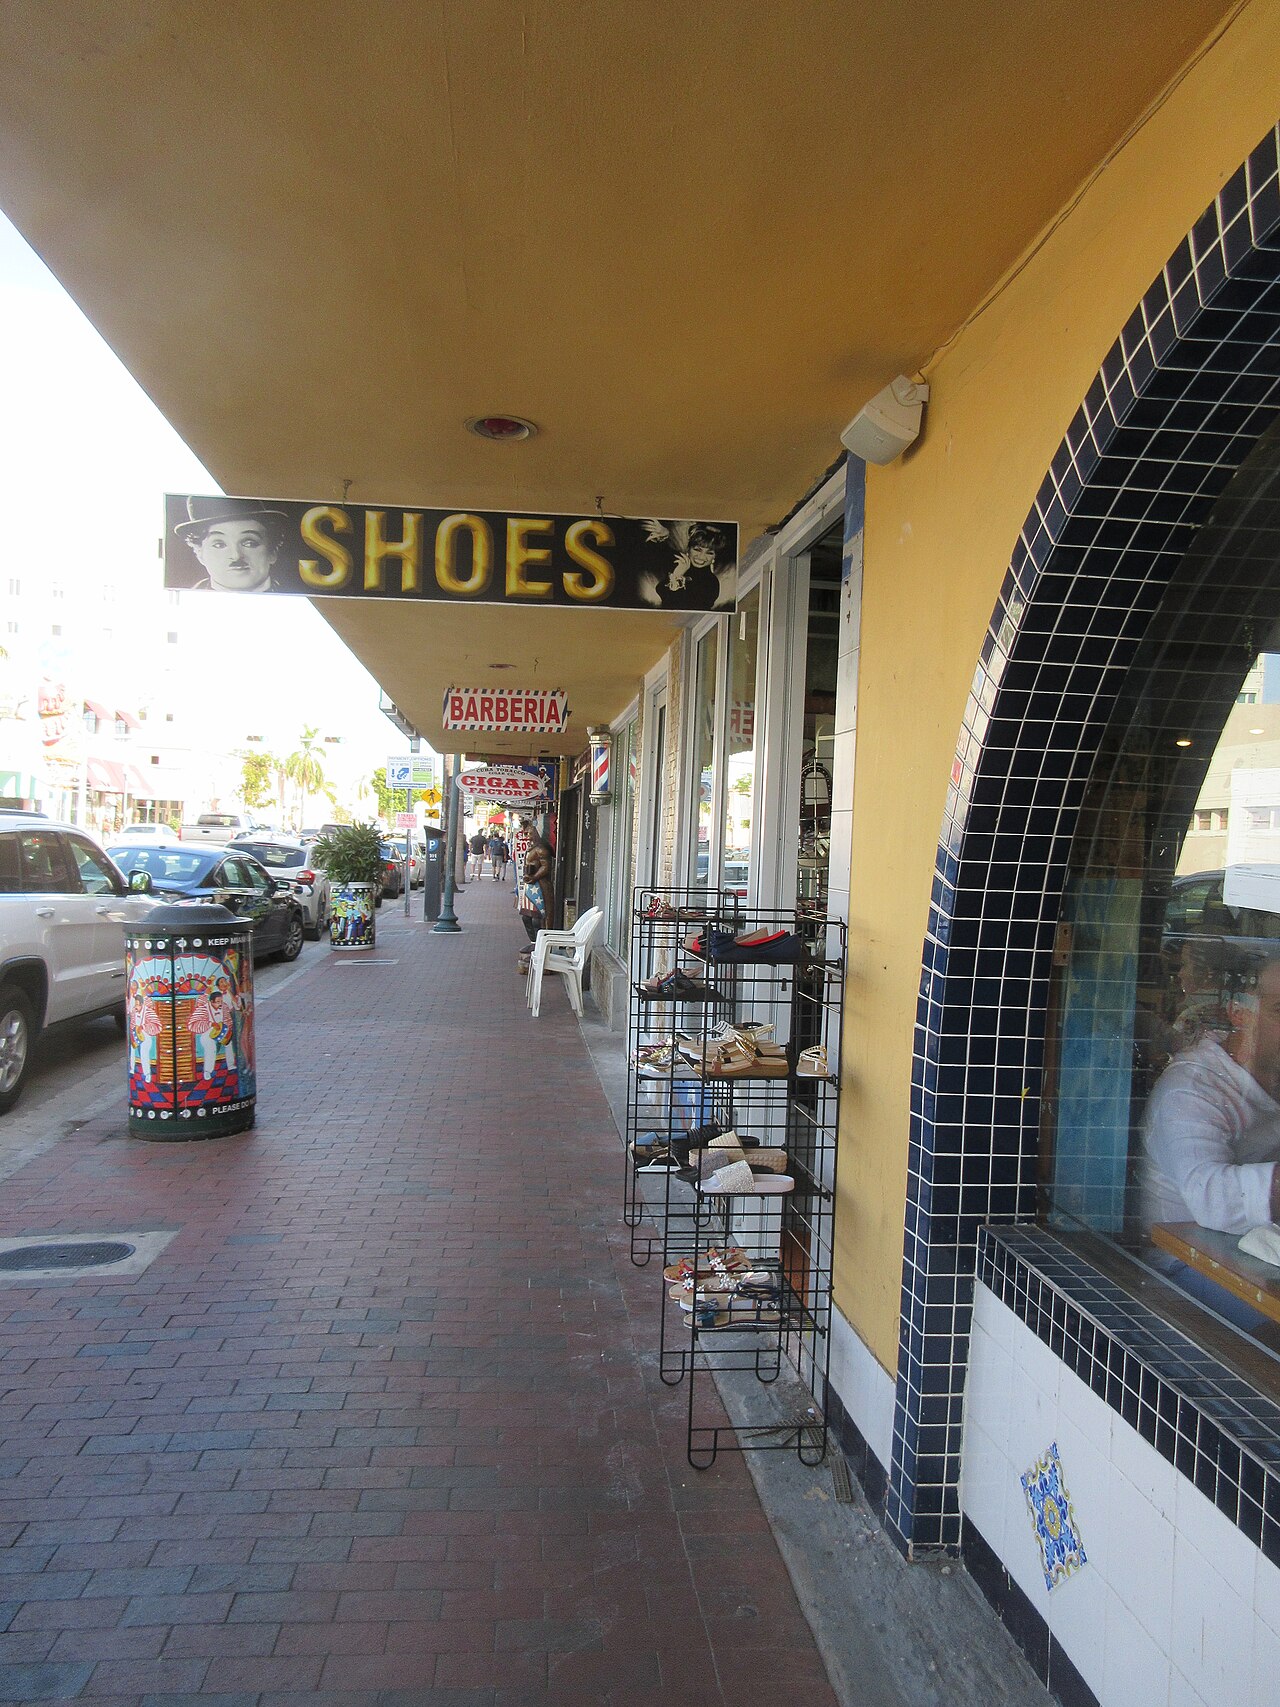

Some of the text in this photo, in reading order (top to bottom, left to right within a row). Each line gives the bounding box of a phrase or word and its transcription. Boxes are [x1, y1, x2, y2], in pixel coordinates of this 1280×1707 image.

[298, 505, 616, 602] SHOES
[450, 695, 560, 724] BARBERIA
[496, 767, 526, 776] TOBACCO
[461, 775, 539, 790] CIGAR
[469, 787, 532, 797] FACTORY
[429, 840, 436, 850] P
[208, 937, 229, 946] KEEP
[212, 1103, 240, 1114] PLEASE
[241, 1100, 249, 1108] DO
